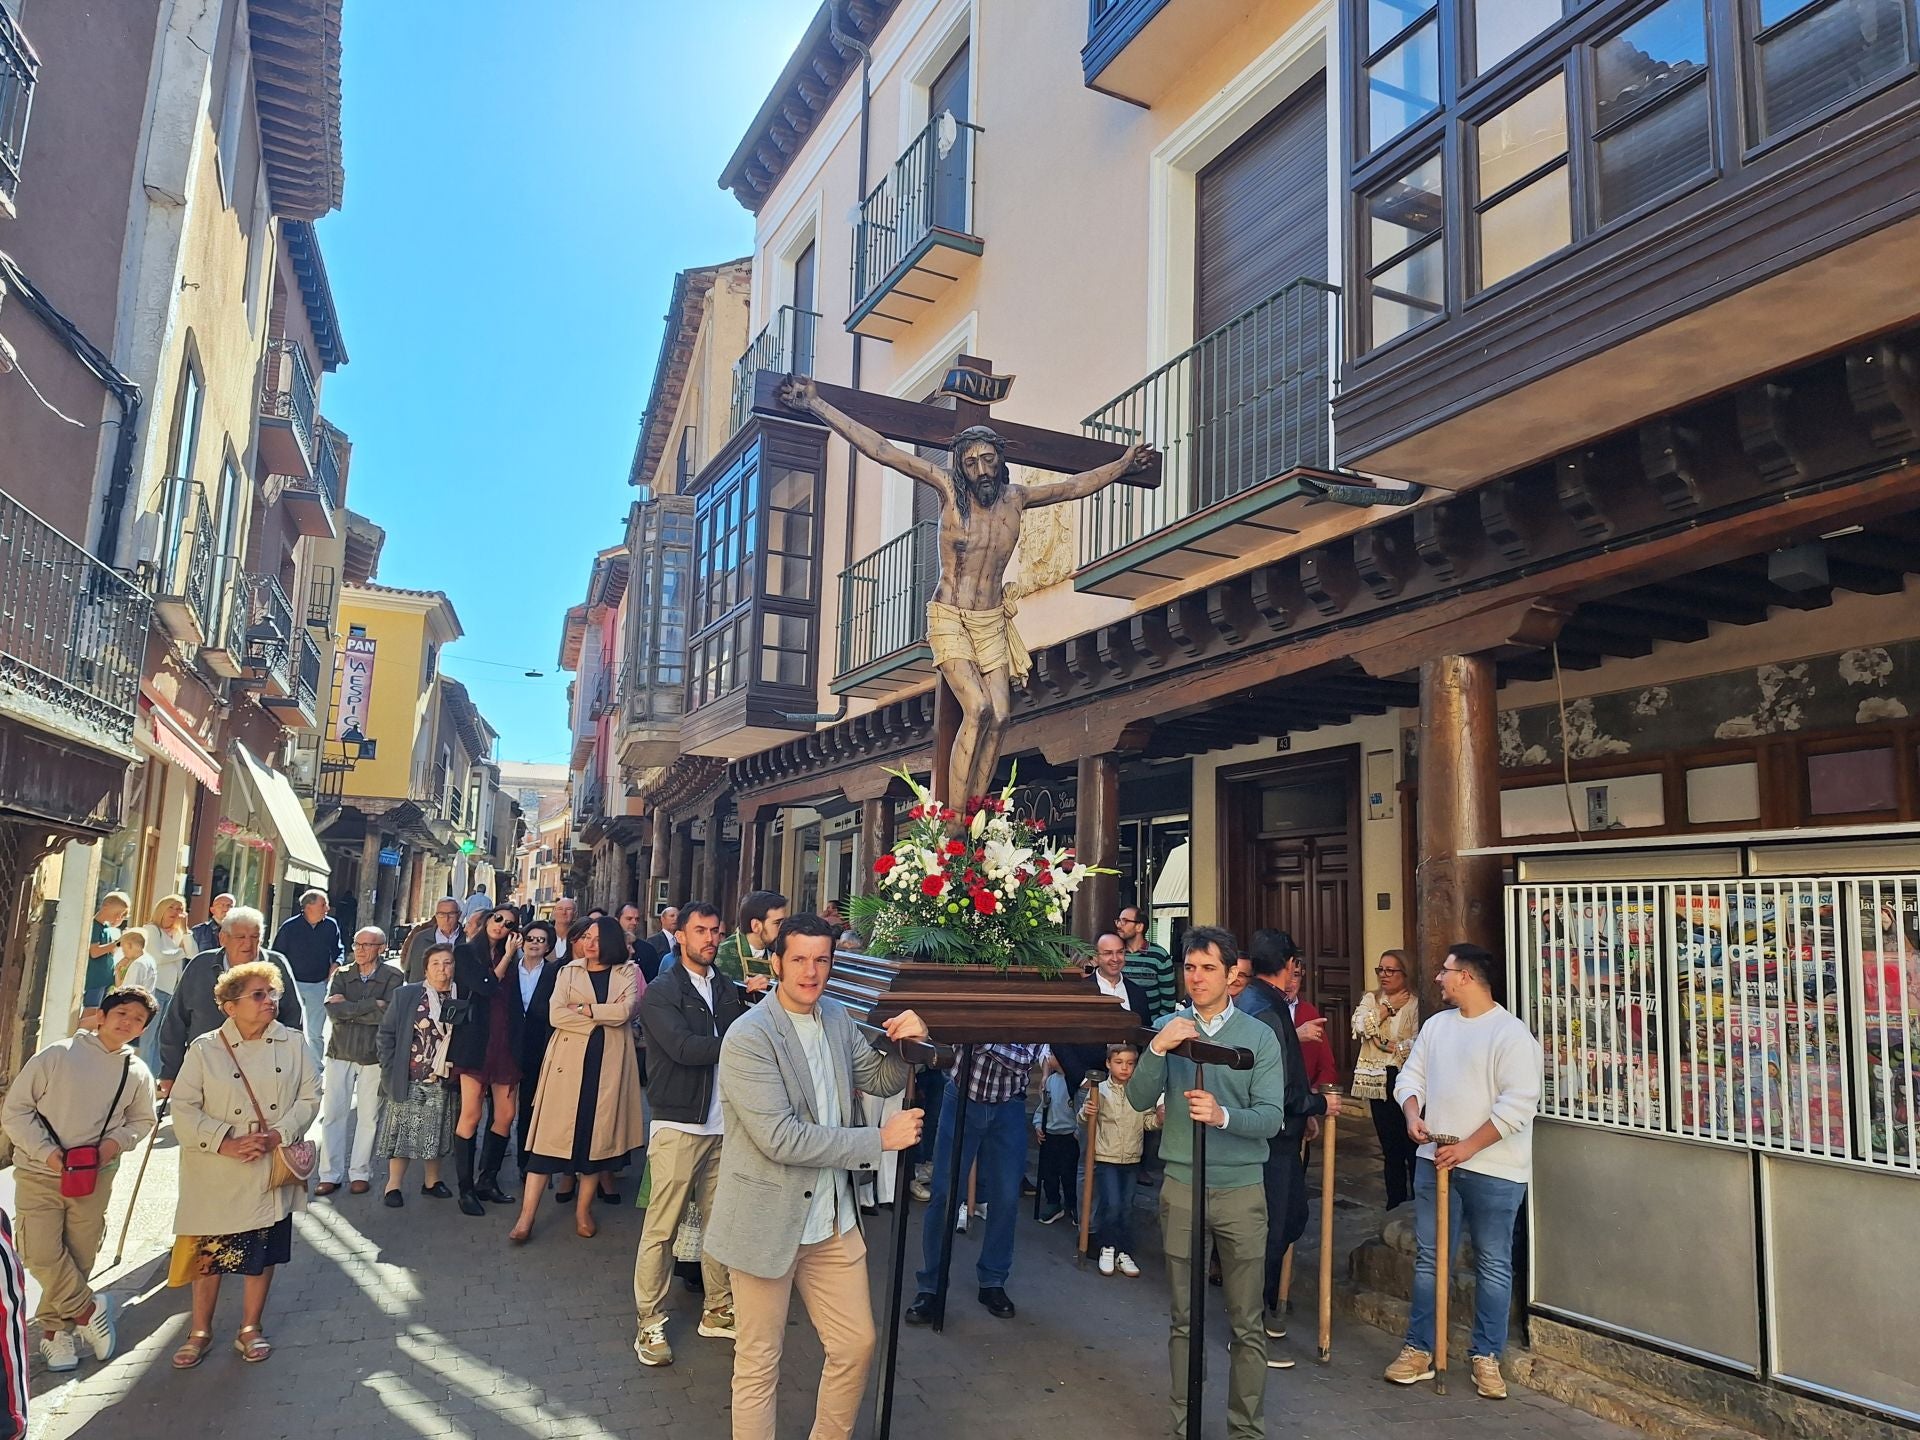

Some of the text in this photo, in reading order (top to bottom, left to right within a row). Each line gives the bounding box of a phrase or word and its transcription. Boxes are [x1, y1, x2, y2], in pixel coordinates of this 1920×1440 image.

[954, 371, 1000, 399] INRI
[347, 639, 375, 652] PAN
[343, 657, 367, 727] LA ESPIG
[1279, 738, 1288, 749] 43
